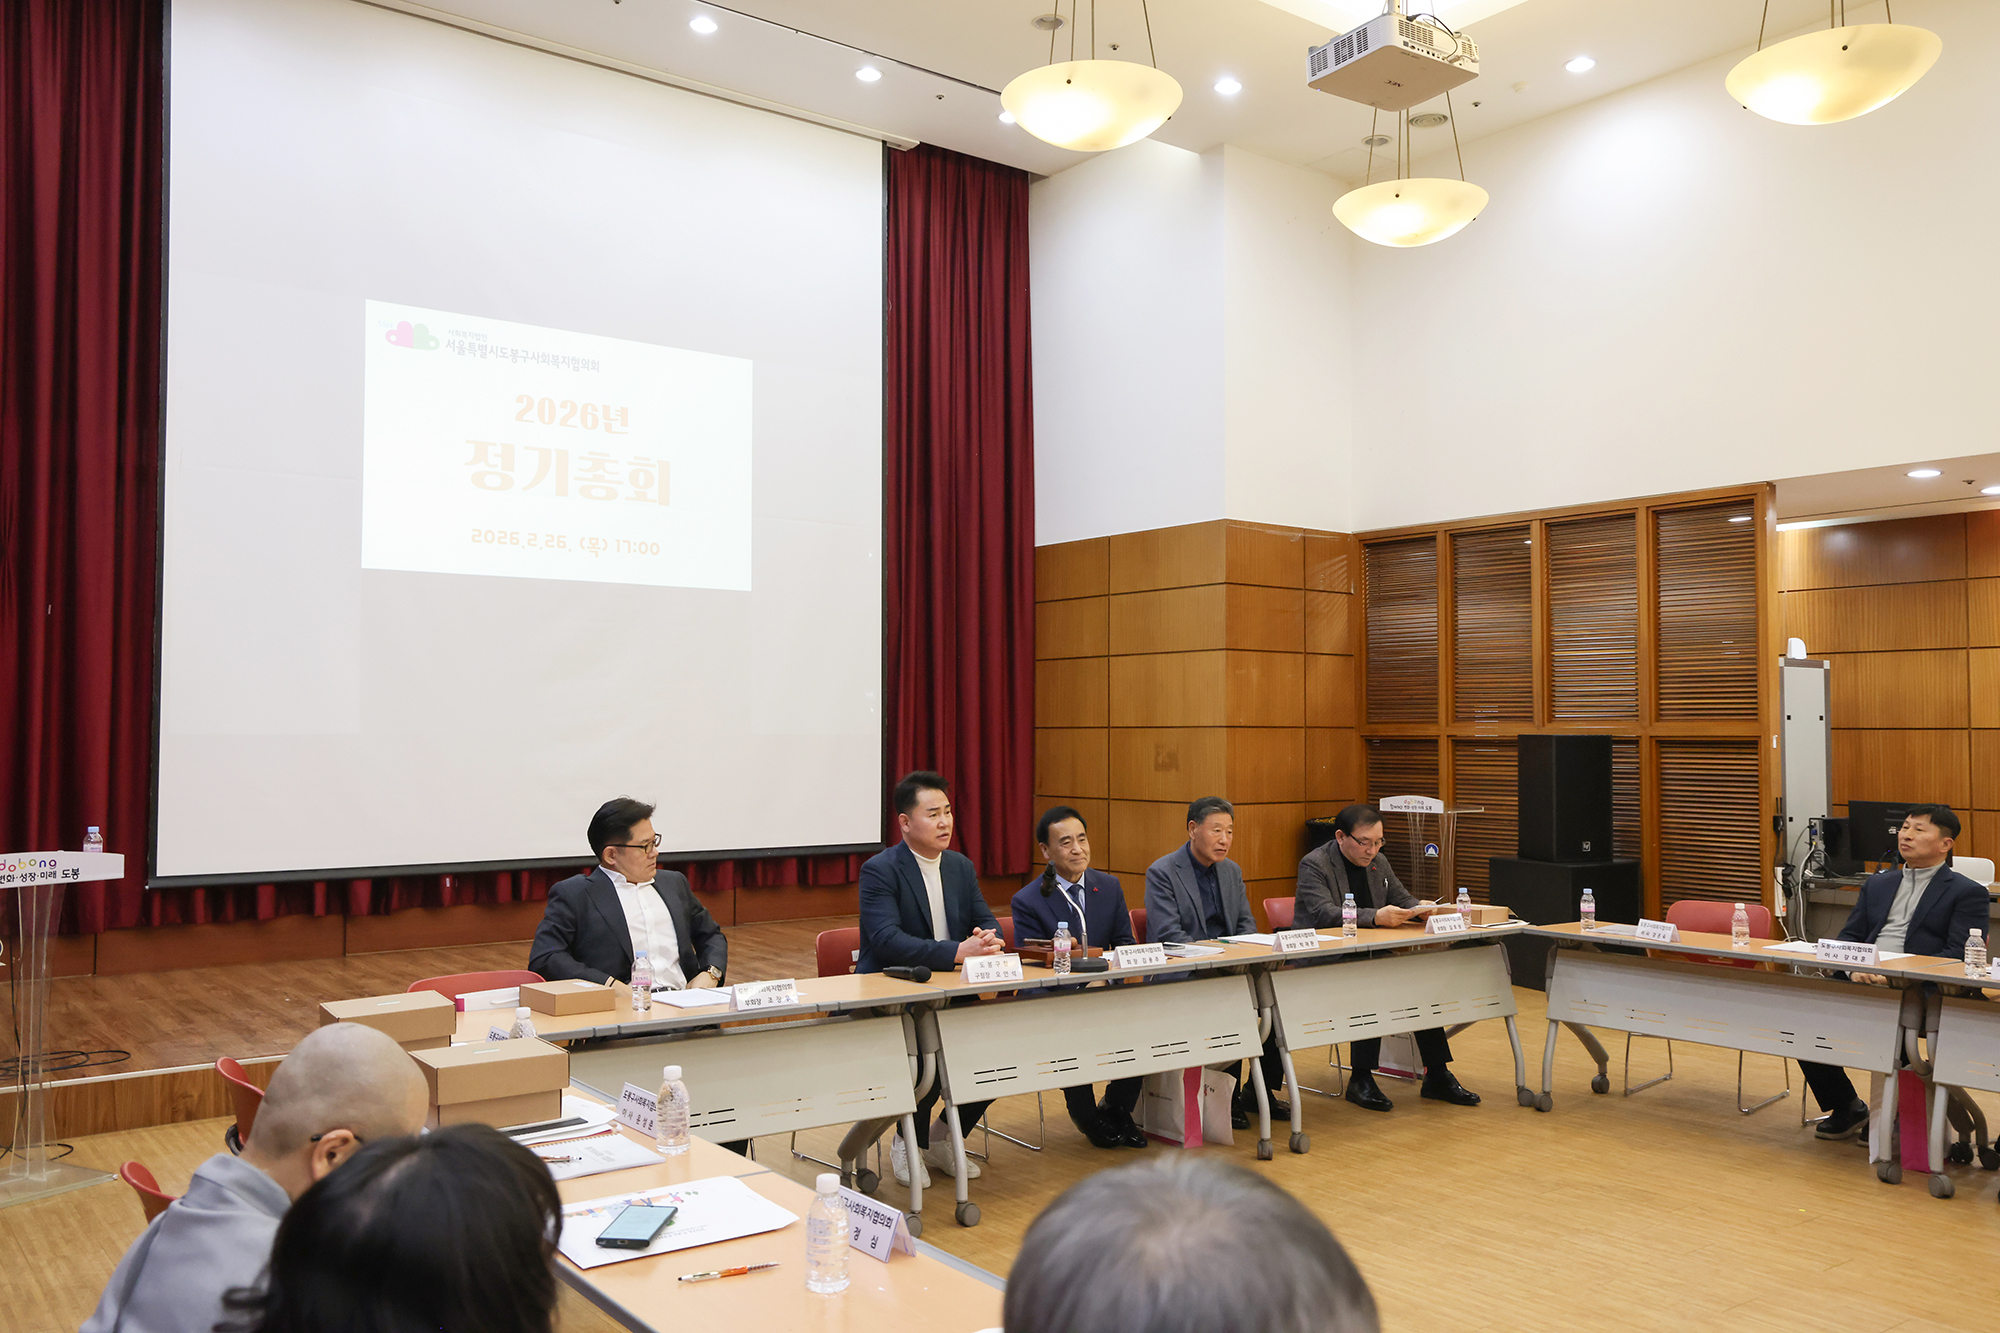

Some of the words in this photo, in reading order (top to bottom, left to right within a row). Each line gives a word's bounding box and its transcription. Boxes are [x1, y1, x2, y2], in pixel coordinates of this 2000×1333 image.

[447, 329, 488, 341] 사회복지법인
[445, 338, 600, 373] 서울특별시도봉구사회복지협의회
[515, 394, 629, 434] 2026년
[464, 439, 671, 506] 정기총회
[579, 536, 608, 557] (목)
[615, 539, 660, 556] 17:00
[61, 868, 80, 880] 도봉
[1821, 943, 1873, 953] 도봉구사회복지협의회
[975, 971, 990, 979] 구청장
[841, 1196, 894, 1230] 구사회복지협의회
